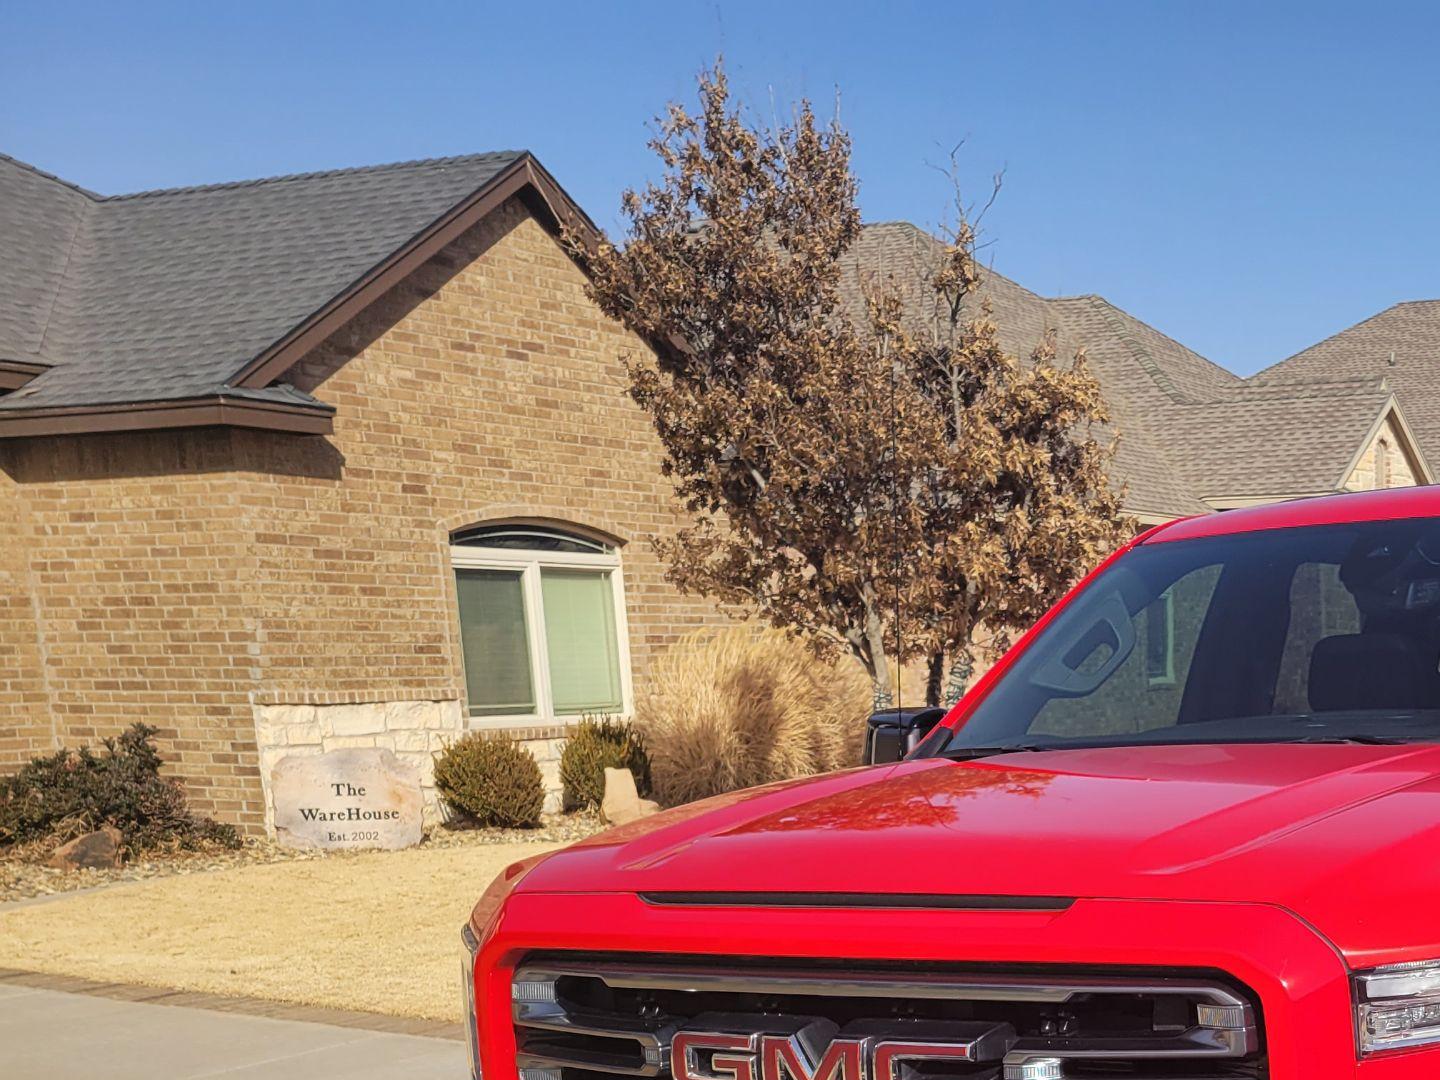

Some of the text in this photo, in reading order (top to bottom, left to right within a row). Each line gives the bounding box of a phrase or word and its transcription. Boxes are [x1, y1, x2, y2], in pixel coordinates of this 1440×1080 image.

[331, 783, 367, 797] The
[299, 807, 400, 821] WareHouse
[351, 831, 379, 841] 2002
